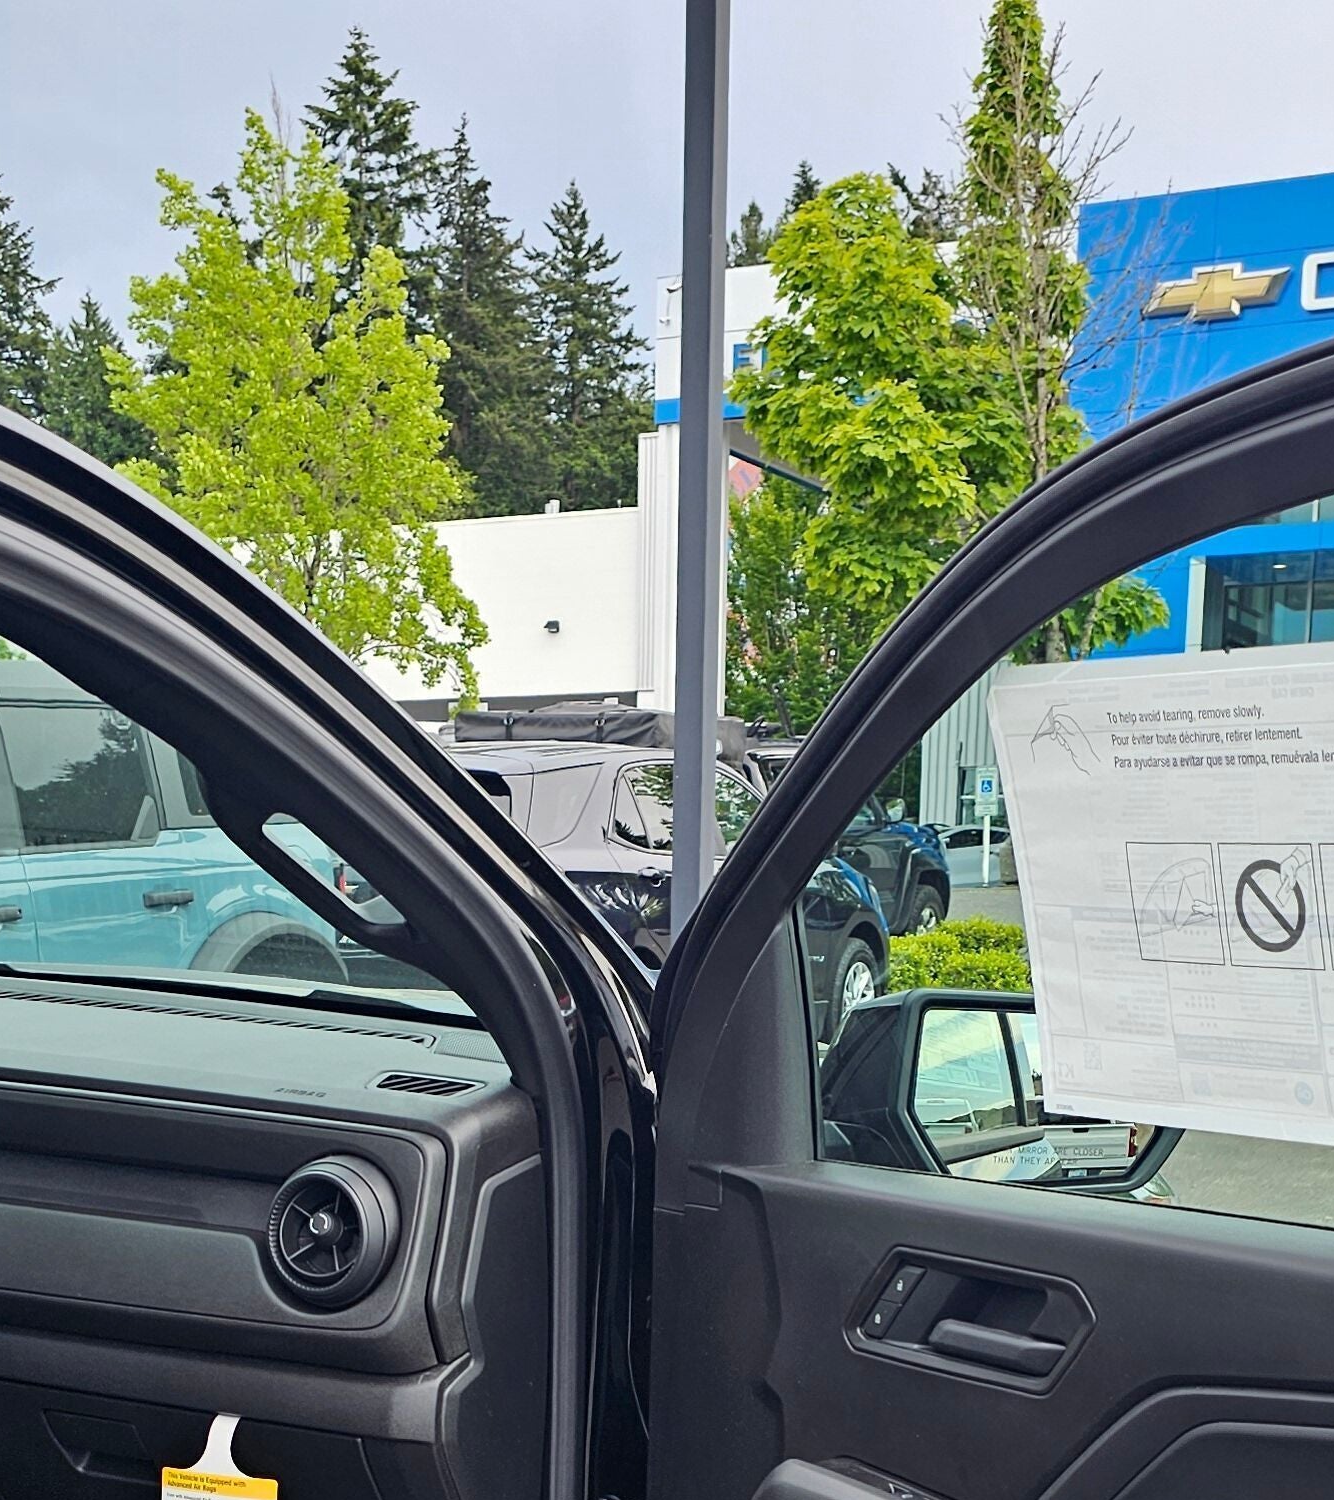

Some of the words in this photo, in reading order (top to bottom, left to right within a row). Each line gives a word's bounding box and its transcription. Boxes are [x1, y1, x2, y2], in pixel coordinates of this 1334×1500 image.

[1107, 712, 1118, 724] To
[1118, 711, 1137, 725] help
[1139, 709, 1161, 722] avoid
[1162, 708, 1196, 723] tearing,
[1198, 707, 1231, 720] remove
[1233, 704, 1264, 720] slowly.
[1111, 734, 1130, 746] Pour
[1131, 732, 1154, 745] éviter
[1155, 733, 1177, 745] toute
[1179, 731, 1224, 744] déchirure,
[1225, 729, 1252, 742] retirer
[1114, 756, 1132, 769] Para
[1133, 756, 1171, 771] ayudarse
[1172, 757, 1178, 767] a
[1180, 754, 1203, 767] evitar
[1206, 754, 1222, 768] que
[1224, 754, 1236, 765] se
[1238, 753, 1269, 768] rompa,
[1270, 749, 1319, 764] remuévala
[1018, 1146, 1048, 1155] MIRROR
[1073, 1147, 1104, 1157] CLOSER
[993, 1155, 1016, 1165] THAN
[1020, 1156, 1041, 1165] THEY
[167, 1479, 193, 1489] Advanced
[202, 1484, 217, 1493] Bags
[179, 1473, 198, 1482] Vehicle
[205, 1476, 232, 1487] Equipped
[233, 1480, 247, 1488] with
